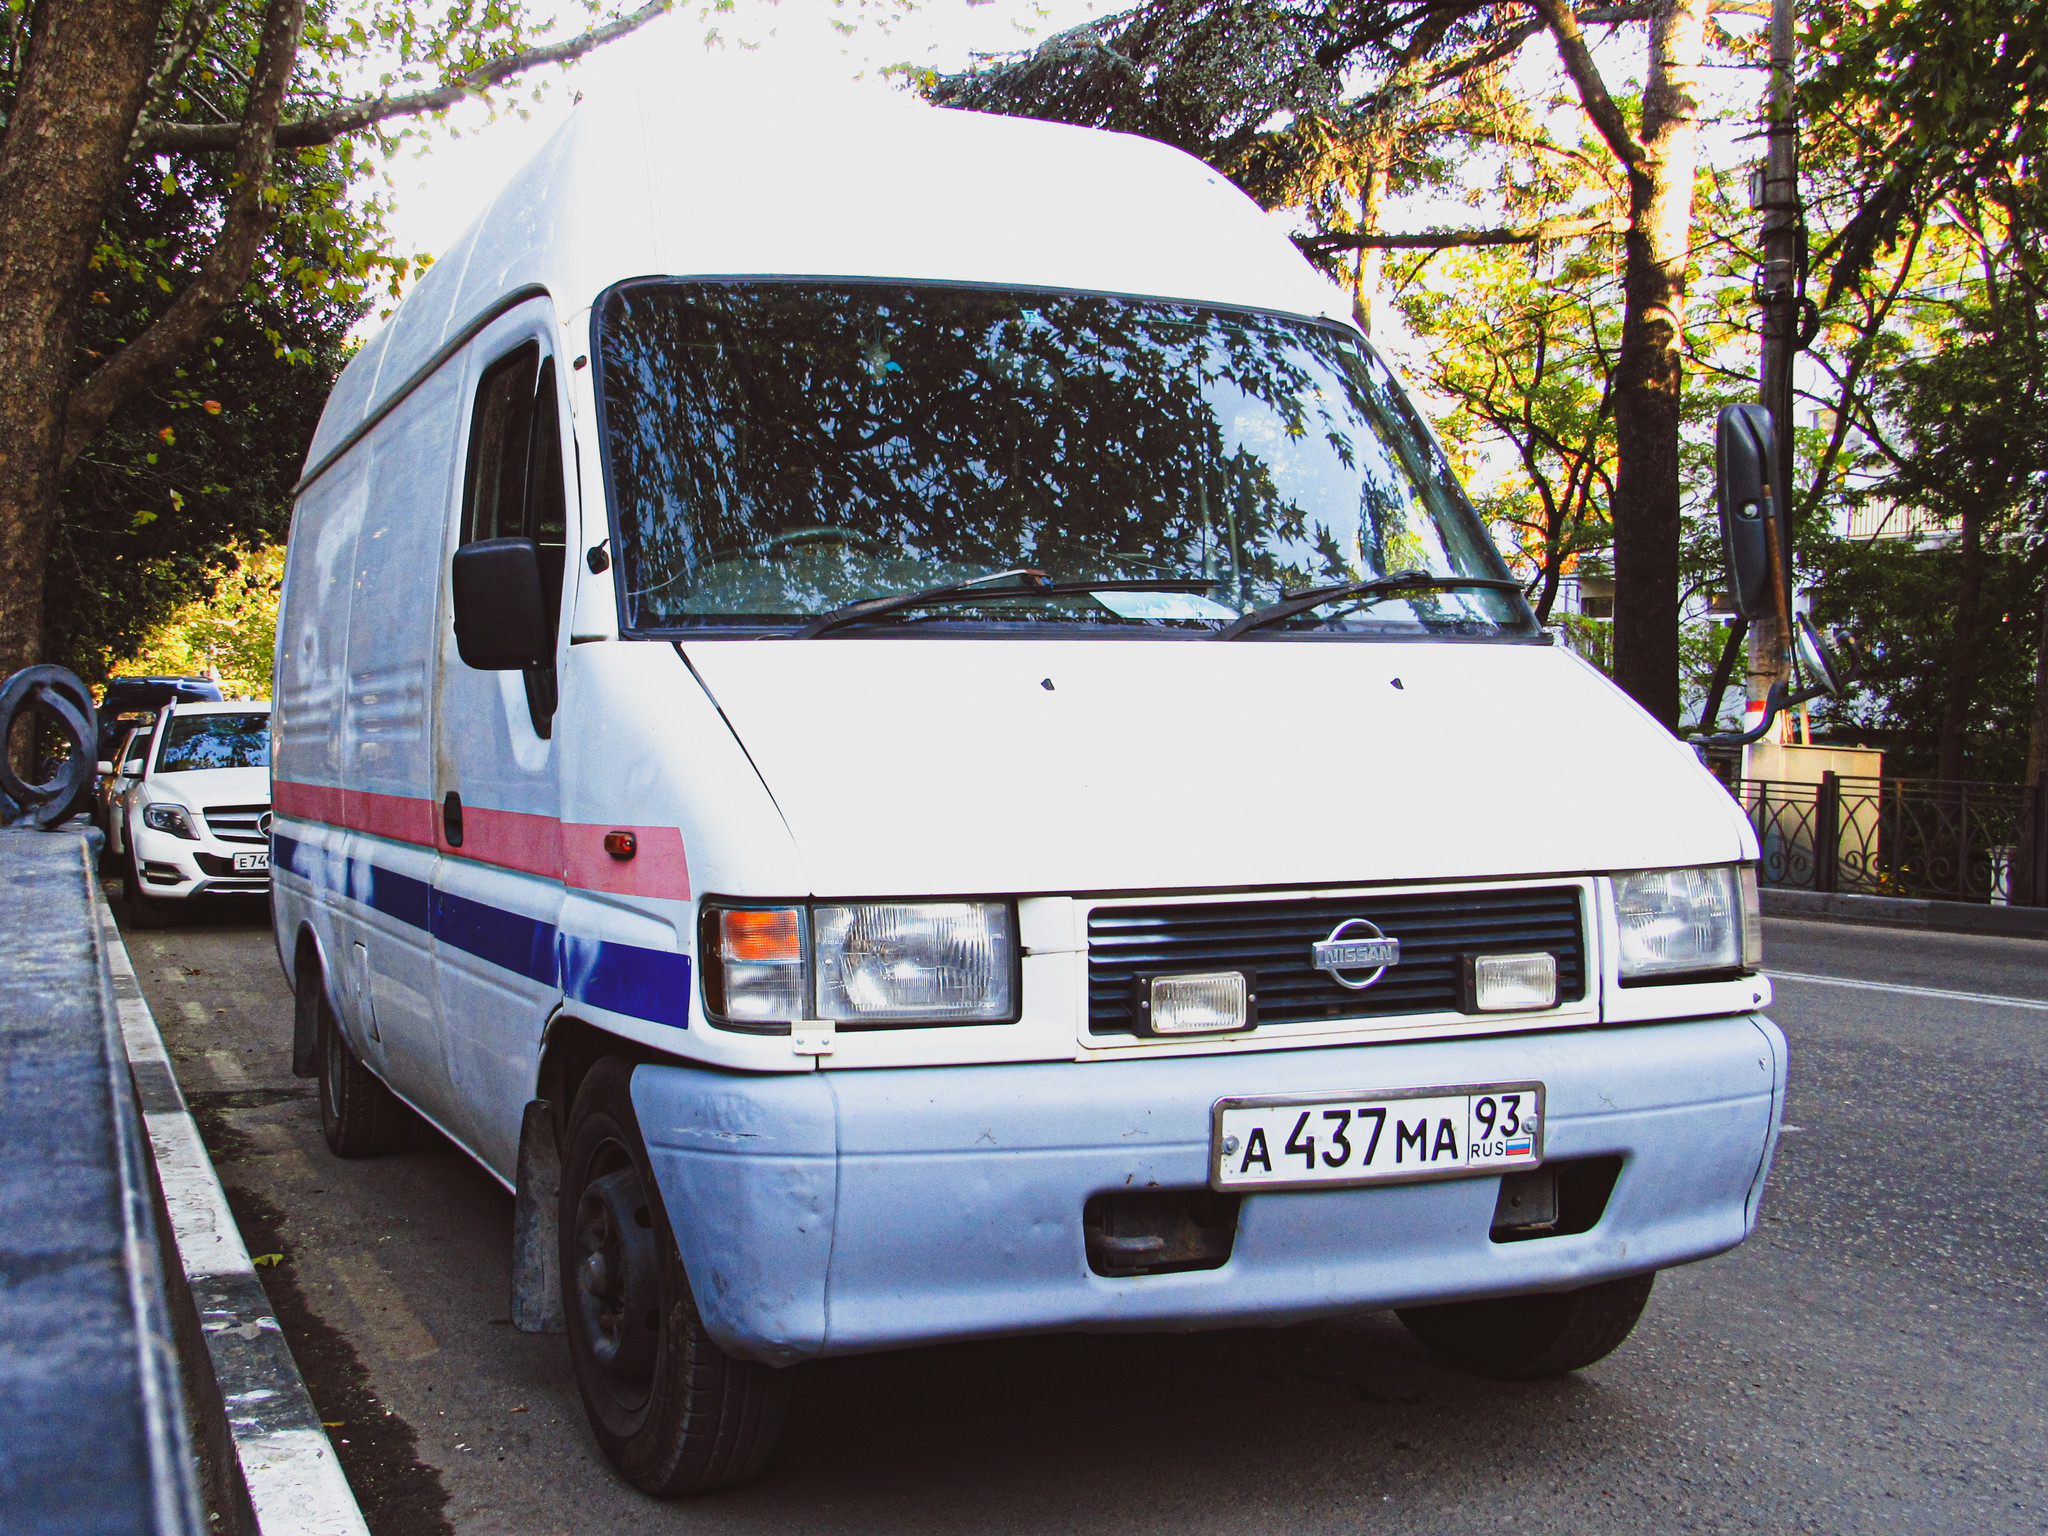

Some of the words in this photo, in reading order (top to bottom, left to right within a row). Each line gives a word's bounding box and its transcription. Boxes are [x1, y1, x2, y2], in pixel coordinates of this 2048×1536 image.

[1324, 945, 1392, 964] NISSAN
[1475, 1094, 1521, 1140] 93
[1471, 1141, 1504, 1158] RUS
